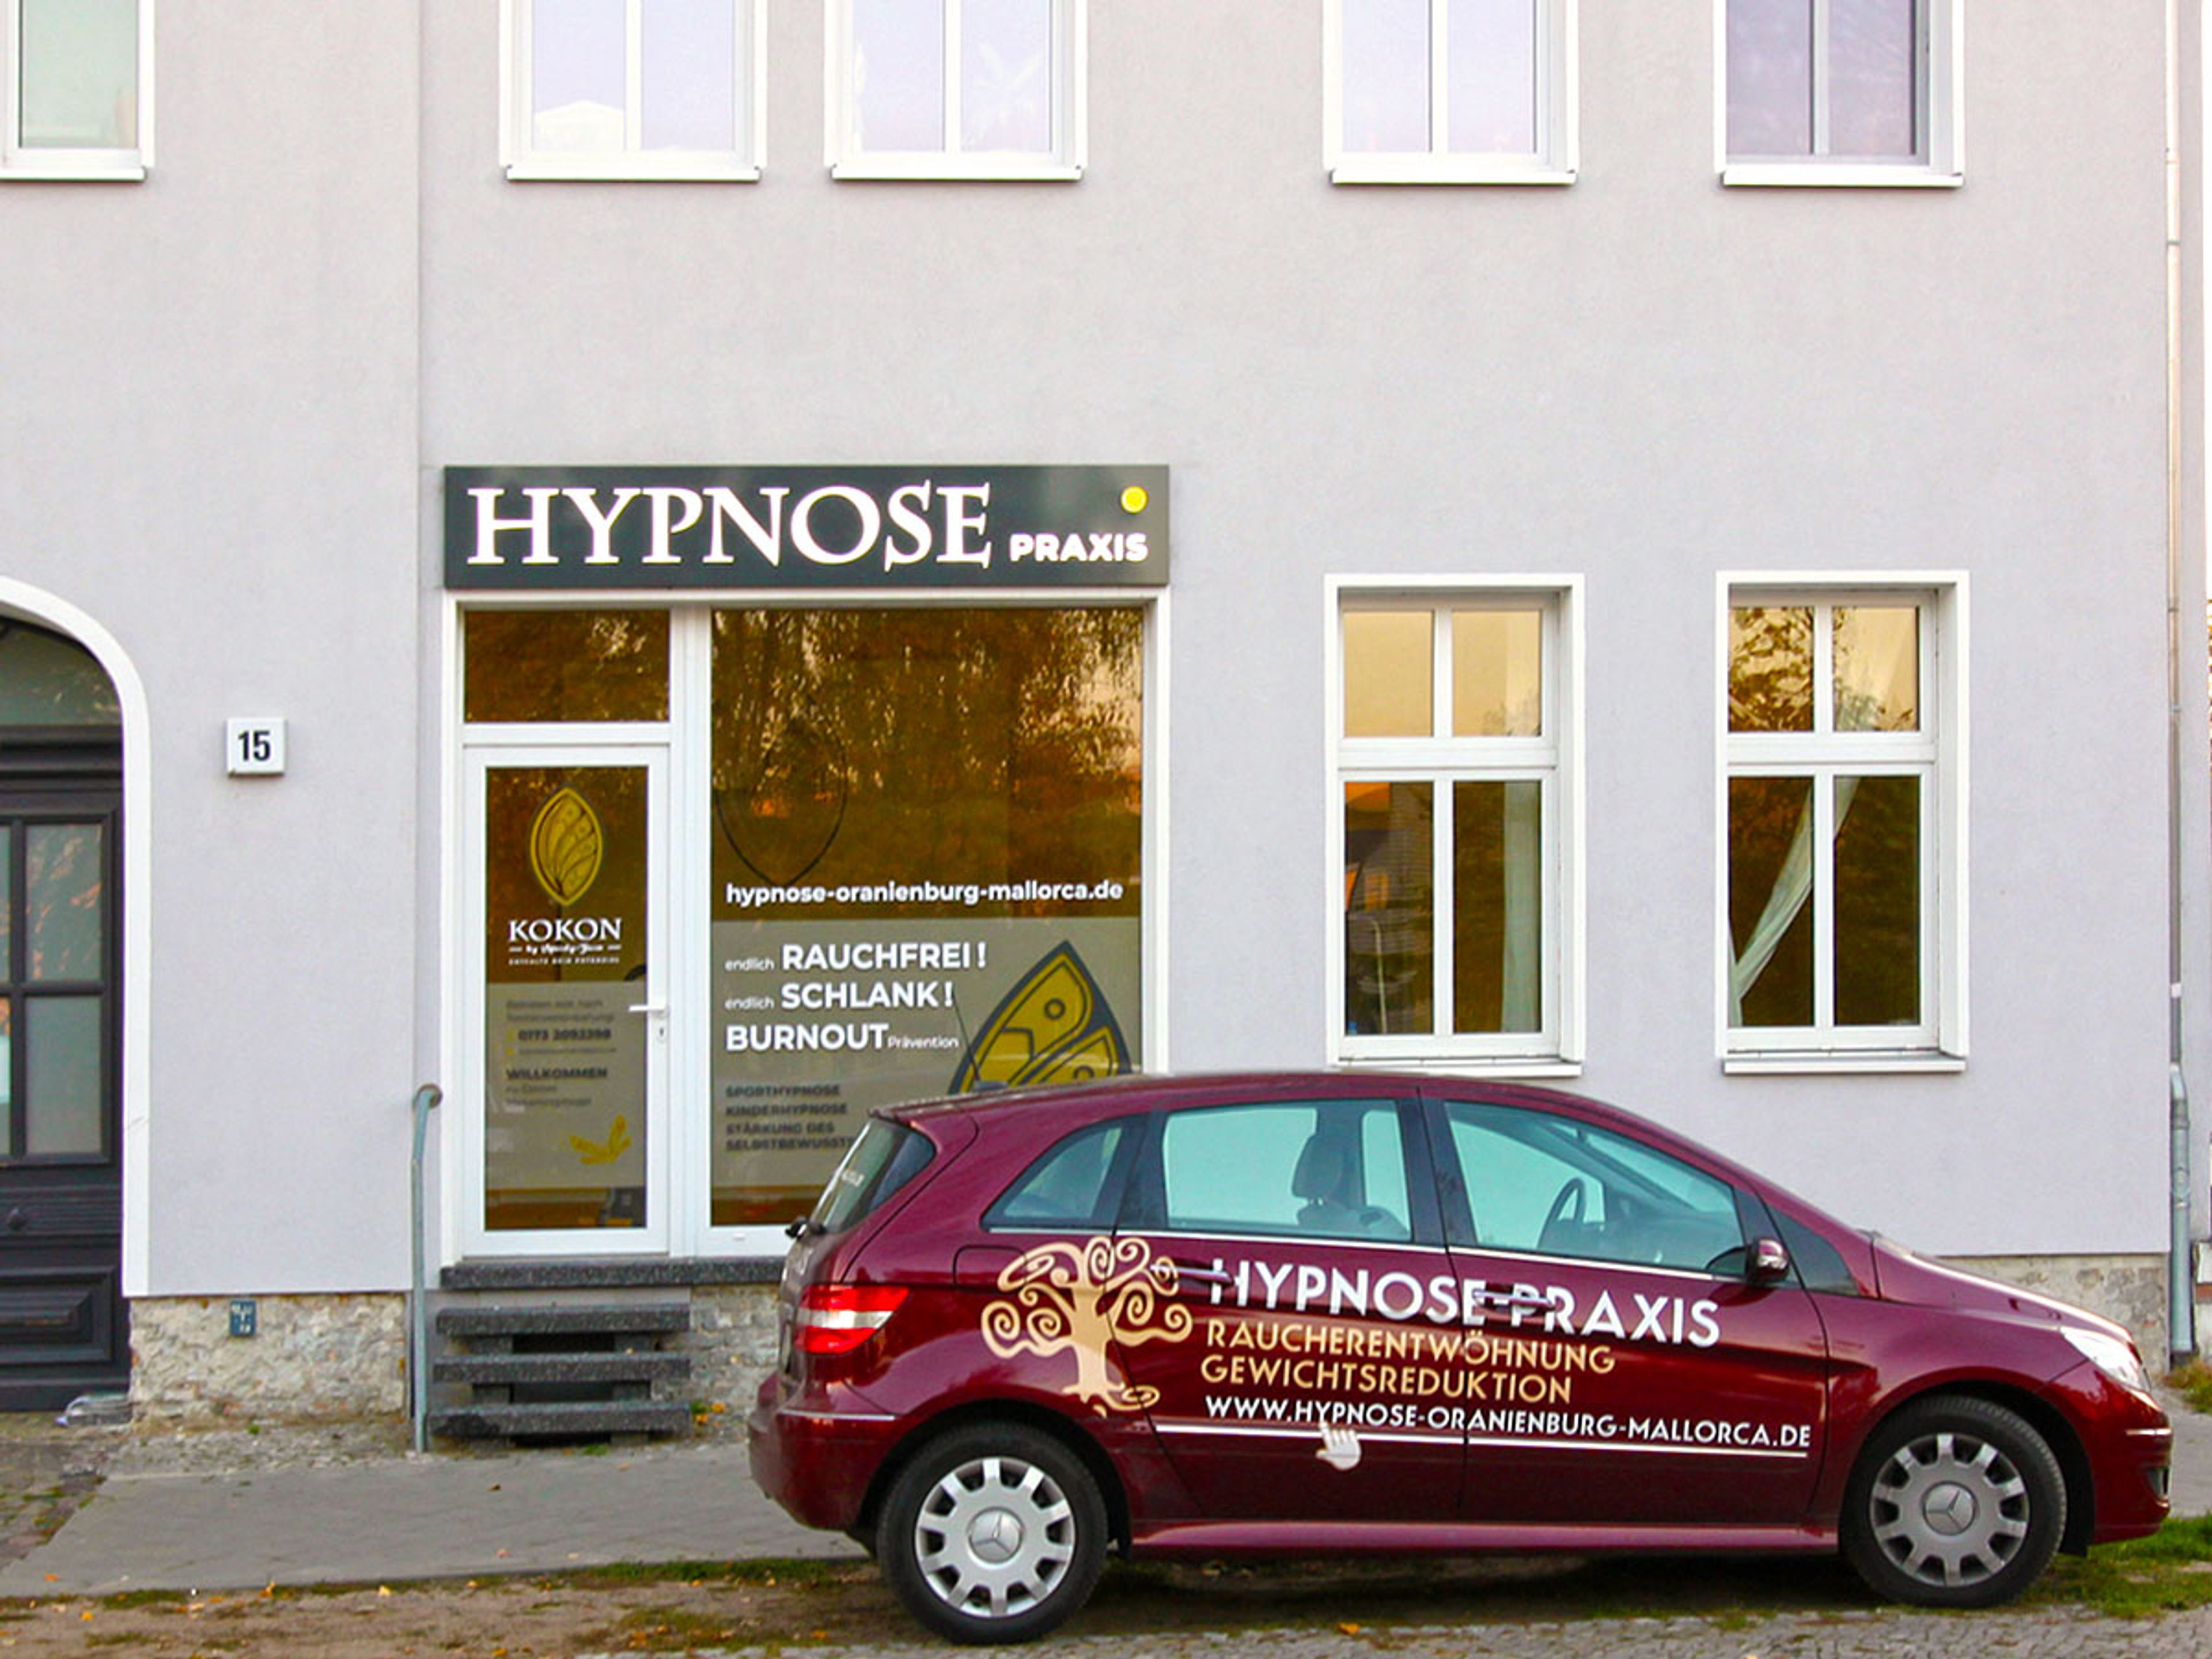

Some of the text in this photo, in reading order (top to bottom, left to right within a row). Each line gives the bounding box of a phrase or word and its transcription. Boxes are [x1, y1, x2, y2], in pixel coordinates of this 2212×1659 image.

[466, 480, 1149, 573] HYPNOSE PRAXIS
[238, 729, 271, 762] 15
[725, 880, 1124, 907] hypnose-oranienburg-mallorca.de
[508, 918, 621, 943] KOKON
[725, 957, 775, 971] endlich
[782, 942, 971, 970] RAUCHFREI
[725, 995, 775, 1009] endlich
[781, 981, 940, 1009] SCHLANK
[725, 1023, 959, 1052] BURNOUT Prävention
[506, 1067, 608, 1080] WILLKOMMEN
[726, 1084, 840, 1097] SPORTHYPNOSE
[726, 1103, 848, 1116] KINDERHYPNOSE
[807, 1121, 835, 1133] DES
[1207, 1318, 1616, 1374] RAUCHERENTWÖHNUNG
[1200, 1353, 1572, 1404] GEWICHTSREDUKTION
[1206, 1395, 1811, 1448] WWW.HYPNOSE-ORANIENBURG-MALLORCA.DE
